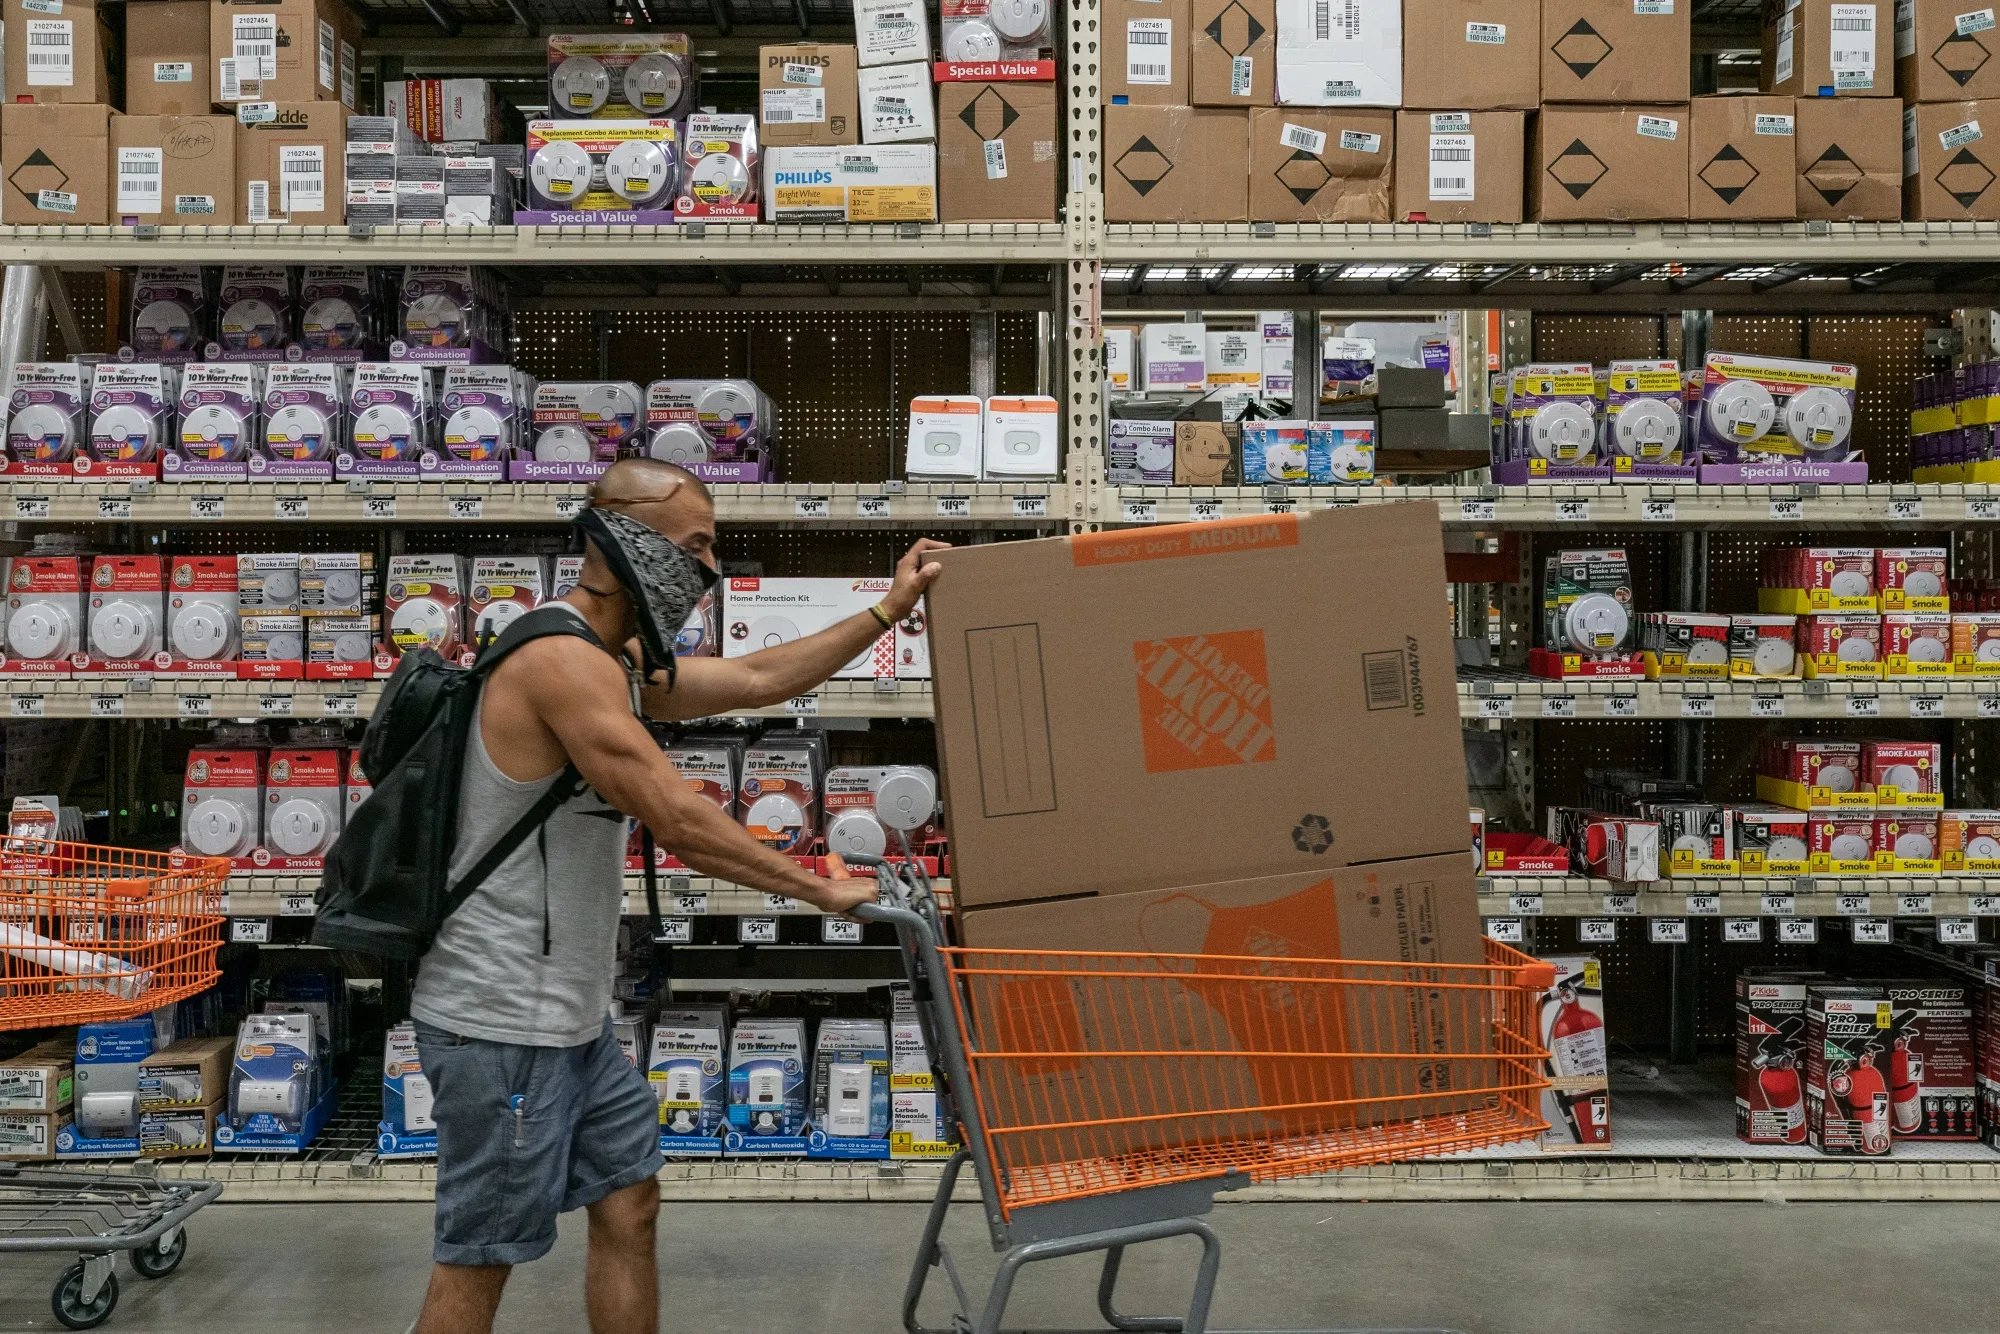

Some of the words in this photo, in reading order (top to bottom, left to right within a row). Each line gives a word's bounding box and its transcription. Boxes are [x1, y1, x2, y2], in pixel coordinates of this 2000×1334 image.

[25, 2, 48, 12] 144239
[34, 22, 65, 30] 21027434
[1469, 34, 1505, 43] 1001824517
[769, 56, 830, 68] PHILIPS
[949, 65, 996, 78] Special
[1000, 64, 1038, 76] Value
[157, 73, 179, 81] 445228
[241, 113, 263, 122] 144239
[649, 120, 669, 128] FIREX
[693, 124, 701, 132] 10
[1343, 141, 1364, 150] 130412
[775, 171, 832, 184] PHILIPS
[778, 190, 799, 200] Bright
[800, 190, 820, 198] White
[709, 206, 745, 215] Smoke
[551, 211, 597, 224] Special
[600, 211, 638, 223] Value
[223, 352, 280, 361] Combination
[410, 350, 466, 360] Combination
[1720, 366, 1762, 376] Replacement
[1763, 369, 1787, 378] Combo
[188, 374, 196, 382] 10
[197, 374, 206, 382] Yr
[206, 373, 248, 384] Worry-Free
[535, 411, 551, 421] $120
[552, 411, 580, 421] VALUE!
[1128, 425, 1150, 433] Combo
[1151, 425, 1171, 433] Alarm
[23, 465, 58, 474] Smoke
[184, 463, 244, 474] Combination
[440, 463, 499, 473] Combination
[525, 463, 572, 477] Special
[703, 464, 740, 476] Value
[1635, 467, 1695, 477] Combination
[1740, 466, 1788, 478] Special
[1792, 466, 1830, 478] Value
[1190, 524, 1281, 549] MEDIUM
[863, 579, 890, 589] Kidde
[755, 594, 796, 602] Protection
[798, 594, 810, 602] Kit
[1839, 598, 1870, 607] Smoke
[1693, 626, 1728, 641] FIREX
[20, 662, 56, 671] Smoke
[187, 661, 222, 670] Smoke
[254, 664, 281, 672] Smoke
[1595, 664, 1631, 674] Smoke
[1845, 663, 1876, 672] Smoke
[748, 761, 756, 770] 10
[765, 761, 808, 771] Worry-Free
[828, 796, 842, 804] $50
[843, 796, 870, 804] VALUE!
[285, 858, 321, 867] Smoke
[1518, 860, 1554, 869] Smoke
[1839, 862, 1870, 871] Smoke
[1758, 987, 1779, 995] Kidde
[1889, 989, 1918, 999] PRO
[1919, 989, 1963, 999] SERIES
[1752, 1001, 1772, 1009] PRO
[1772, 1001, 1803, 1009] SERIES
[1828, 1014, 1856, 1024] PRO
[1751, 1024, 1766, 1033] 110
[1827, 1023, 1869, 1033] SERIES
[100, 1039, 119, 1047] Carbon
[120, 1038, 144, 1046] Monoxide
[658, 1042, 666, 1050] 10
[676, 1042, 718, 1052] Worry-Free
[928, 1144, 957, 1152] Alarm
